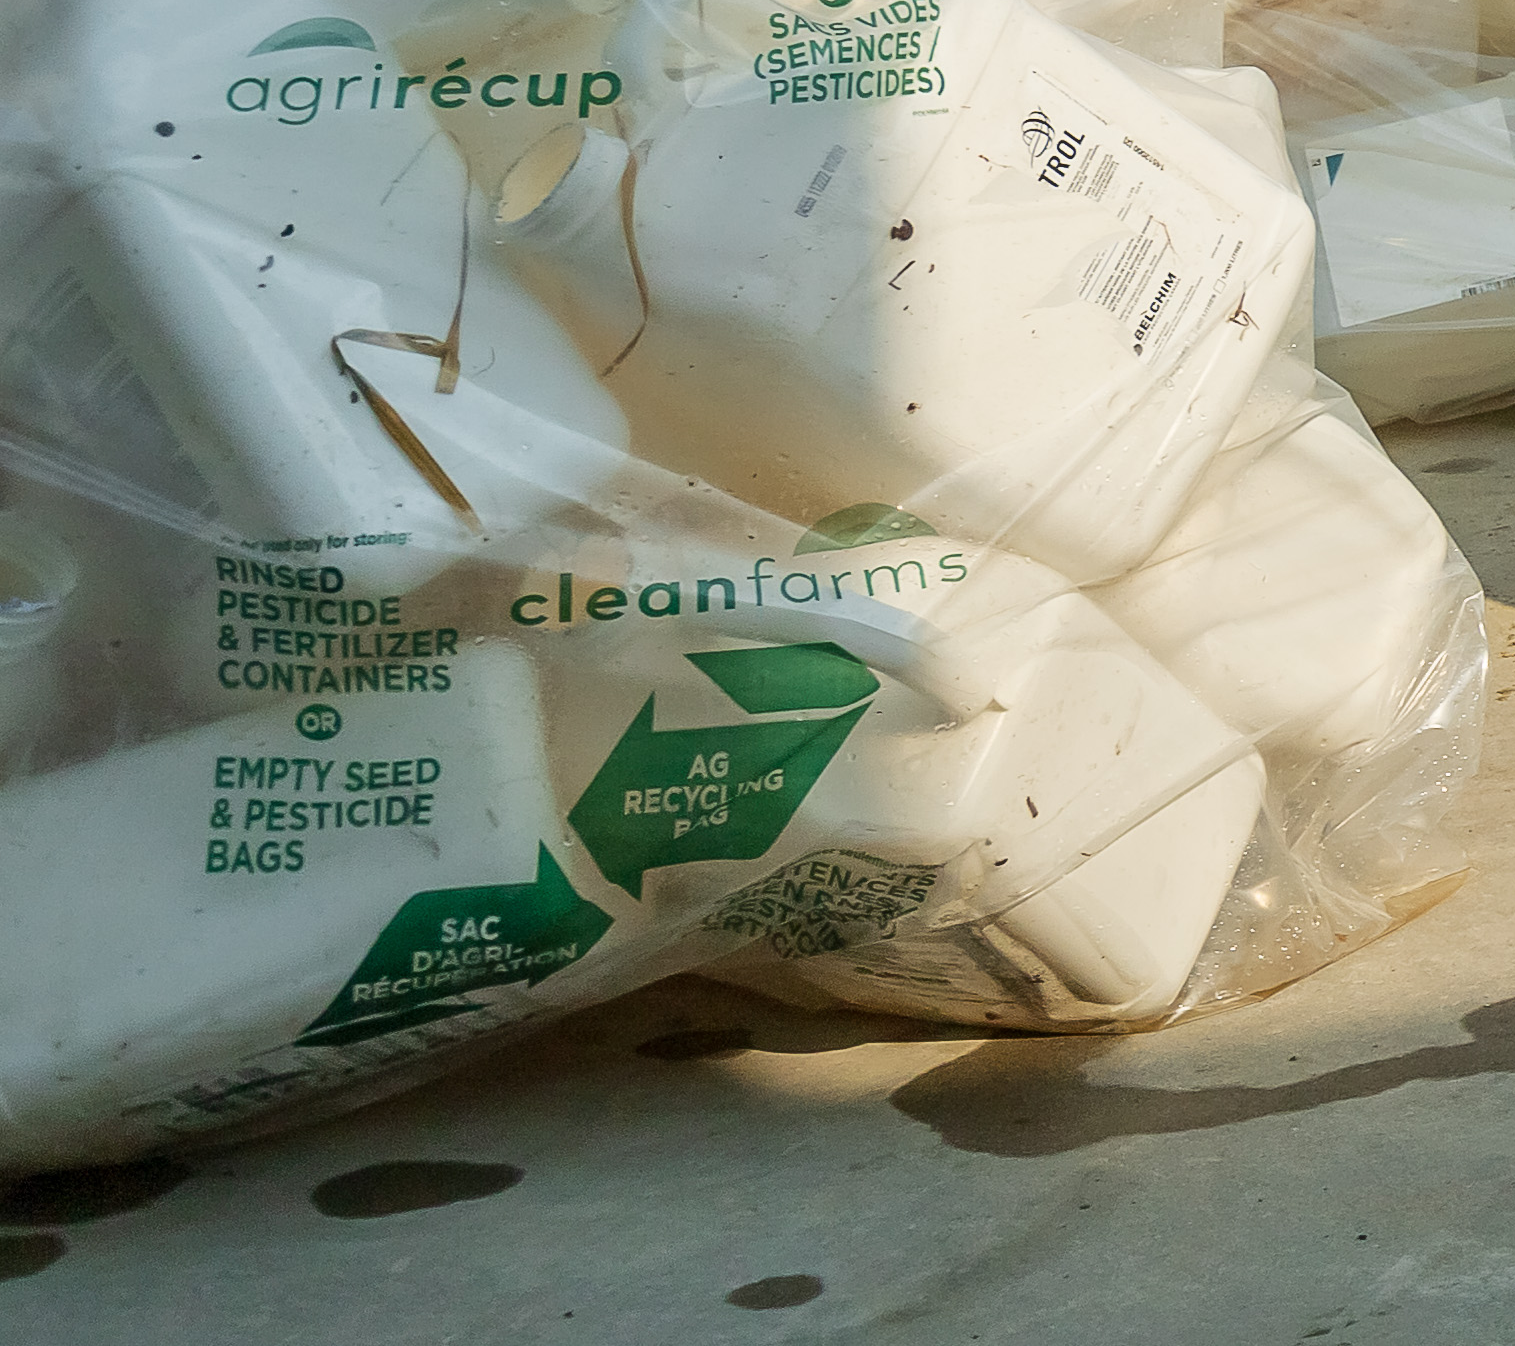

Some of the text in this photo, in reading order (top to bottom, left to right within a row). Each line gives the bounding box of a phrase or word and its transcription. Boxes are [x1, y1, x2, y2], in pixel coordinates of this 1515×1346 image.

[753, 25, 942, 80] (SEMENCES /
[225, 57, 624, 126] agrirécup
[769, 67, 945, 105] PESTICIDES)
[1037, 129, 1087, 189] TROL
[1133, 271, 1179, 342] BELCHIM
[326, 535, 350, 550] for
[215, 556, 345, 595] RINSED
[509, 552, 969, 627] cleanfarms
[216, 589, 401, 628] PESTICIDE
[217, 623, 459, 659] & FERTILIZER
[217, 658, 452, 694] CONTAINERS
[214, 755, 443, 793] EMPTY SEED
[686, 750, 731, 781] AG
[622, 767, 785, 817] RECYCLING
[208, 792, 435, 833] & PESTICIDE
[204, 838, 306, 875] BAGS
[440, 915, 502, 944] SAC
[410, 942, 526, 974] D'AGRI-
